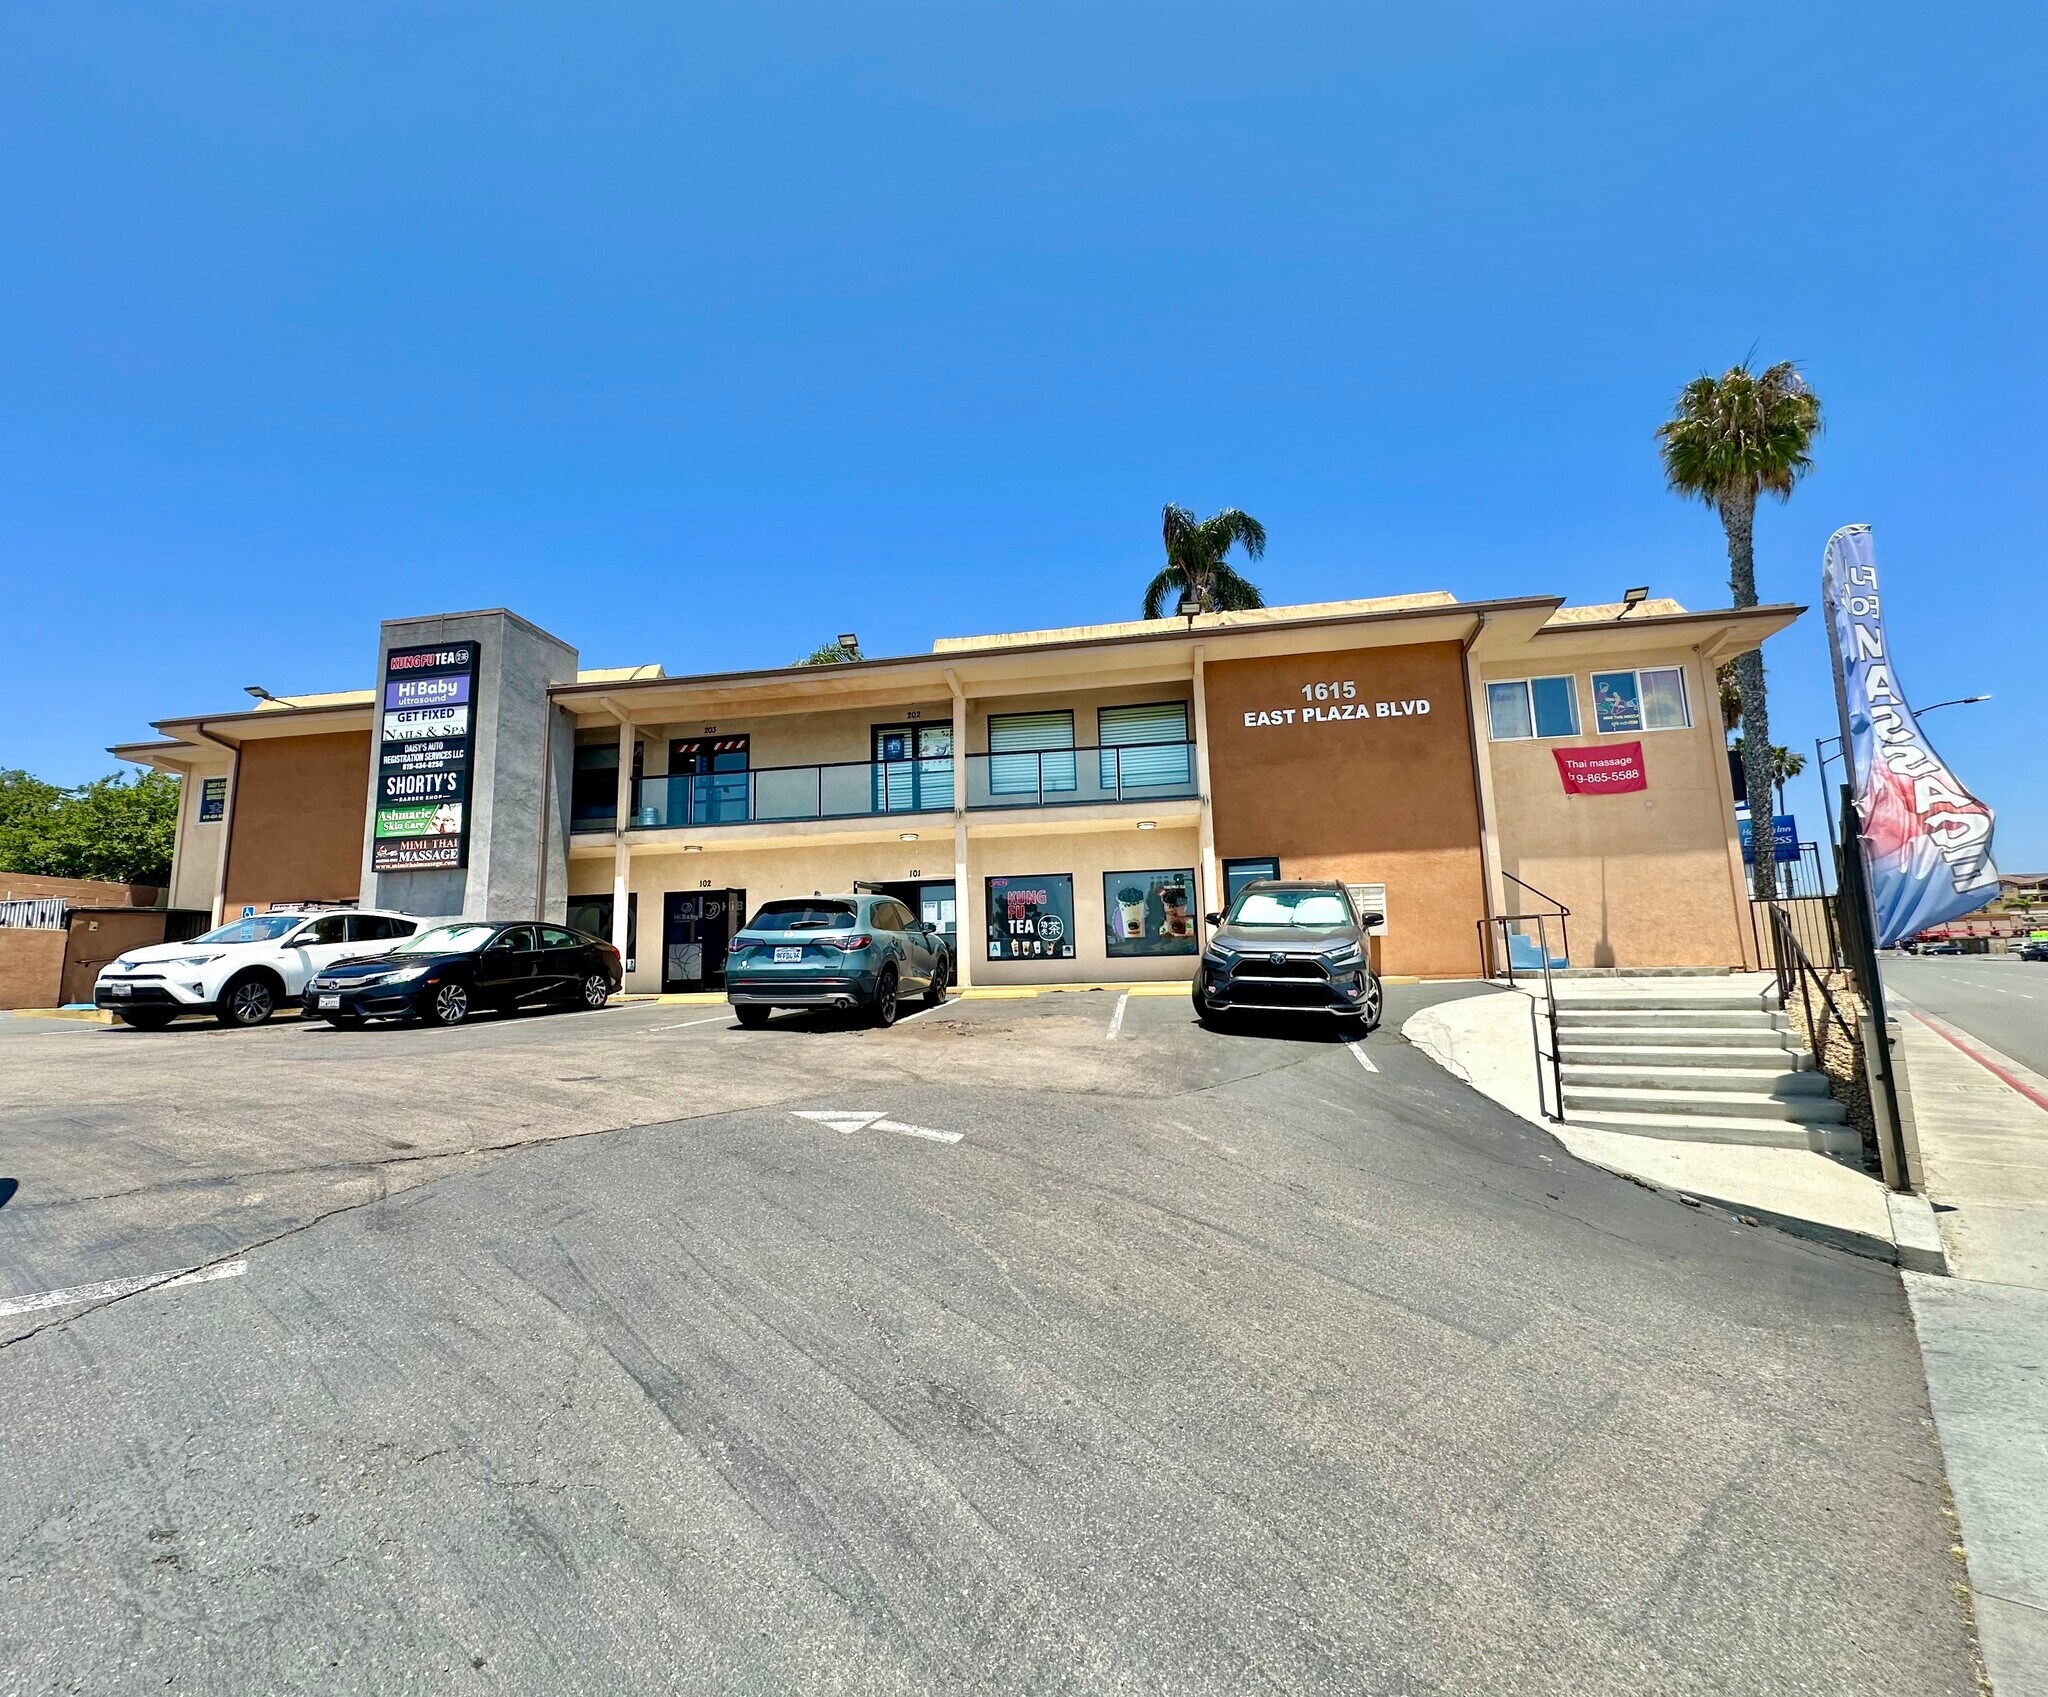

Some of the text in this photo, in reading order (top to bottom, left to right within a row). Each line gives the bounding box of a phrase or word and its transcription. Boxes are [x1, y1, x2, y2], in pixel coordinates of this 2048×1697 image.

[436, 651, 454, 665] TEA
[399, 679, 458, 697] Hi Baby
[1302, 681, 1356, 701] 1615
[399, 694, 446, 705] ultrasound
[397, 708, 454, 723] GET FIXED
[907, 711, 921, 719] 202
[1244, 699, 1430, 727] EAST PLAZA BLVD
[385, 724, 466, 740] NAILS & SPA
[404, 741, 443, 753] DAISY'S AUTO
[383, 749, 464, 765] REGISTRATION SERVICES LLC
[1566, 757, 1632, 769] Thai massage
[386, 772, 457, 795] SHORTY'S
[380, 808, 432, 822] Ashmarie
[384, 820, 425, 831] Skin Care
[400, 839, 458, 850] MIMI THAI
[399, 848, 458, 862] MASSAGE
[909, 869, 921, 877] 101
[1007, 890, 1047, 905] KUNG
[1007, 905, 1025, 919] FU
[1008, 920, 1034, 934] TEA
